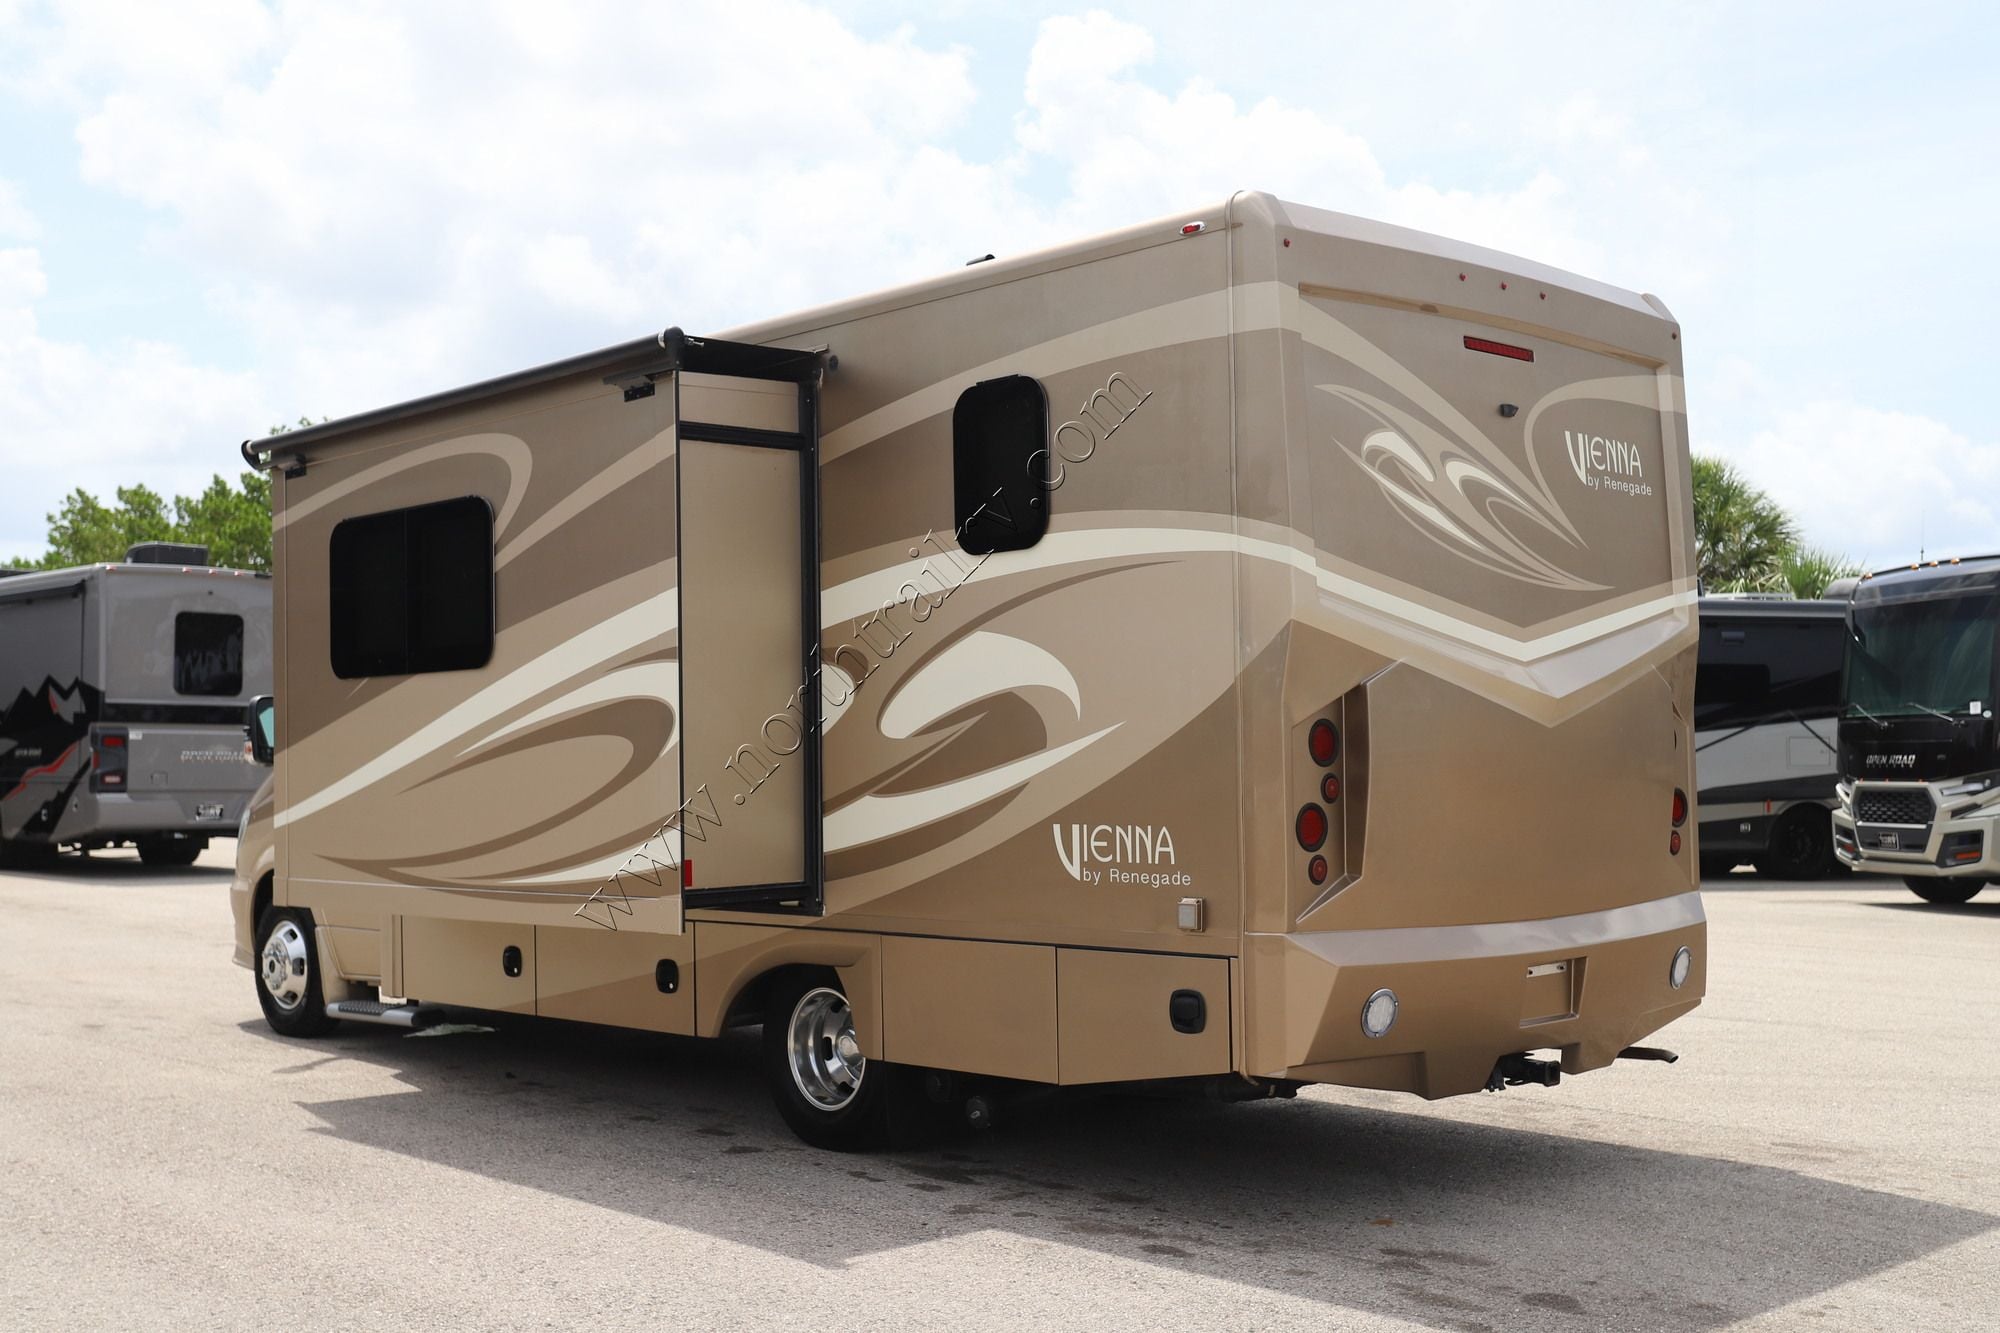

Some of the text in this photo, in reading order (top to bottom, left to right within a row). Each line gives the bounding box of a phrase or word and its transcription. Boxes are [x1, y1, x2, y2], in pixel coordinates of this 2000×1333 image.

[1564, 430, 1643, 486] VIENNA
[1587, 473, 1653, 496] by Renegade
[1888, 754, 1916, 765] ROAD
[1052, 823, 1176, 881] VIENNA
[1083, 866, 1192, 889] by Renegade
